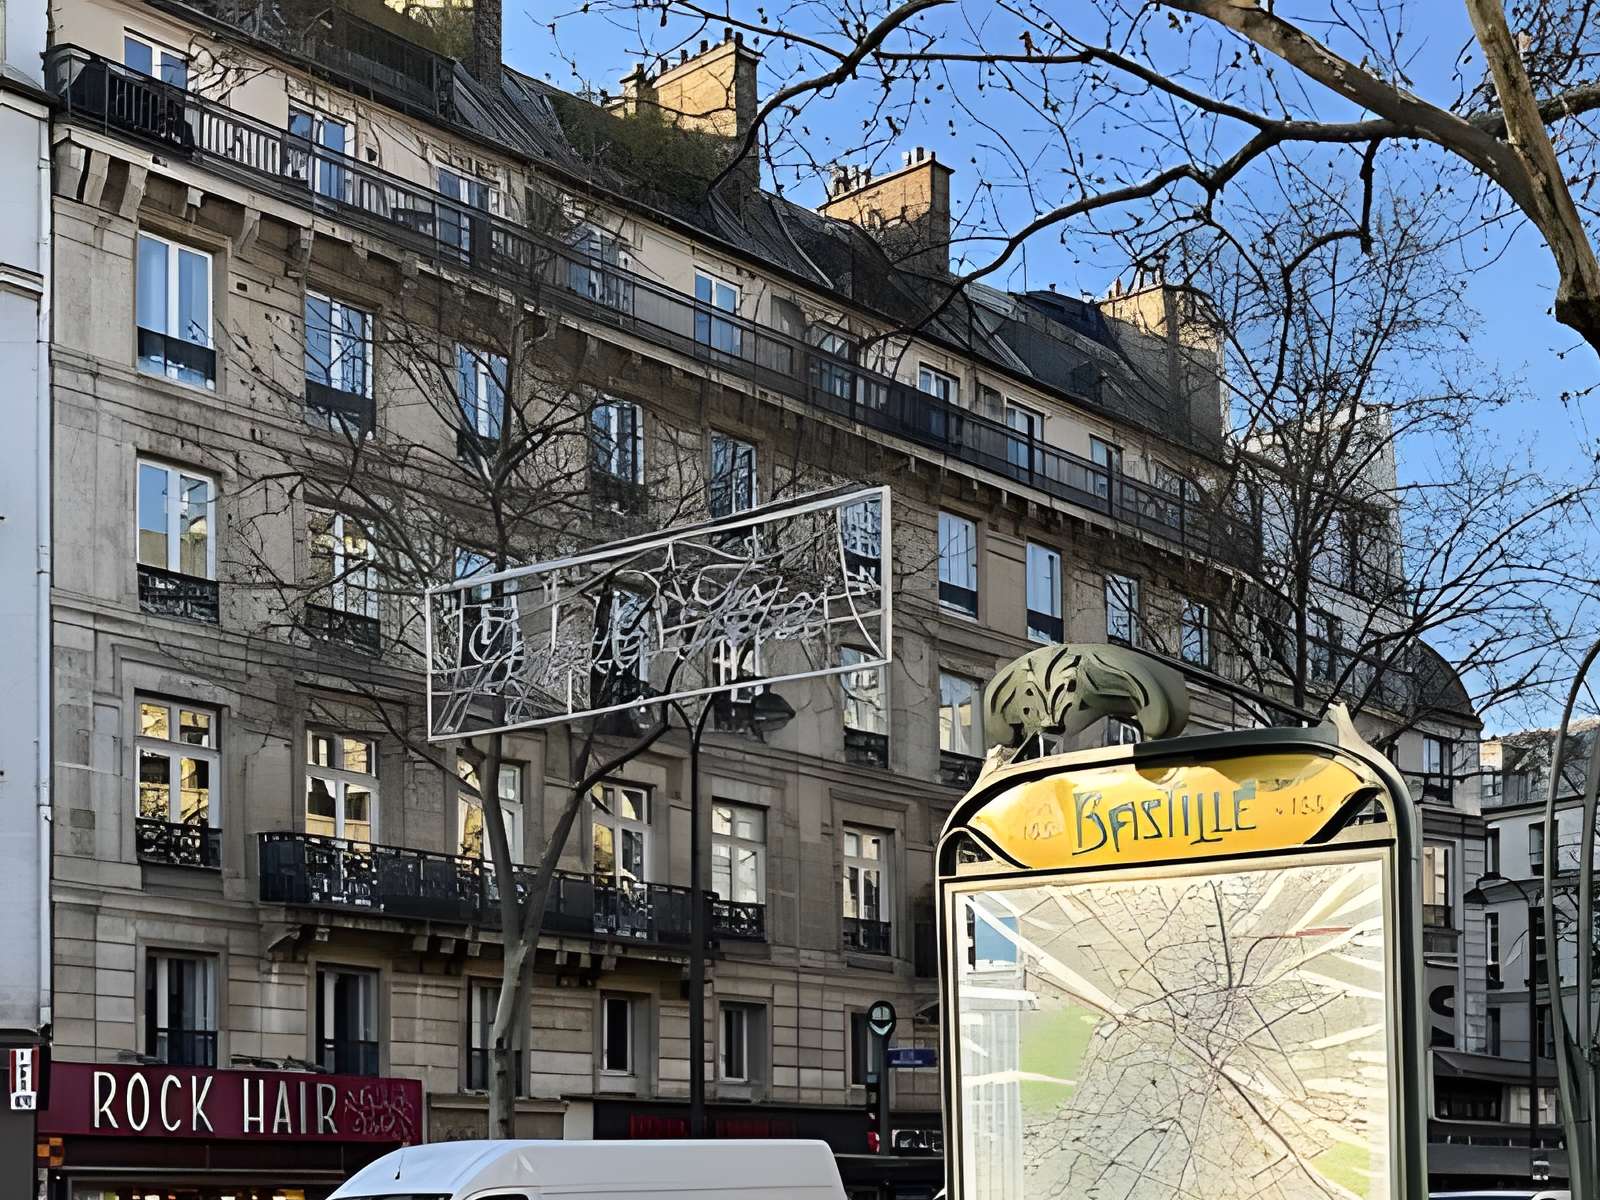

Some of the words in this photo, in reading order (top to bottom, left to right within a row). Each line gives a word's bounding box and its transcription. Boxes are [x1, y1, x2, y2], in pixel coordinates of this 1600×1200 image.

[1072, 778, 1257, 856] BASTILLE
[93, 1070, 215, 1133] ROCK
[243, 1077, 338, 1135] HAIR
